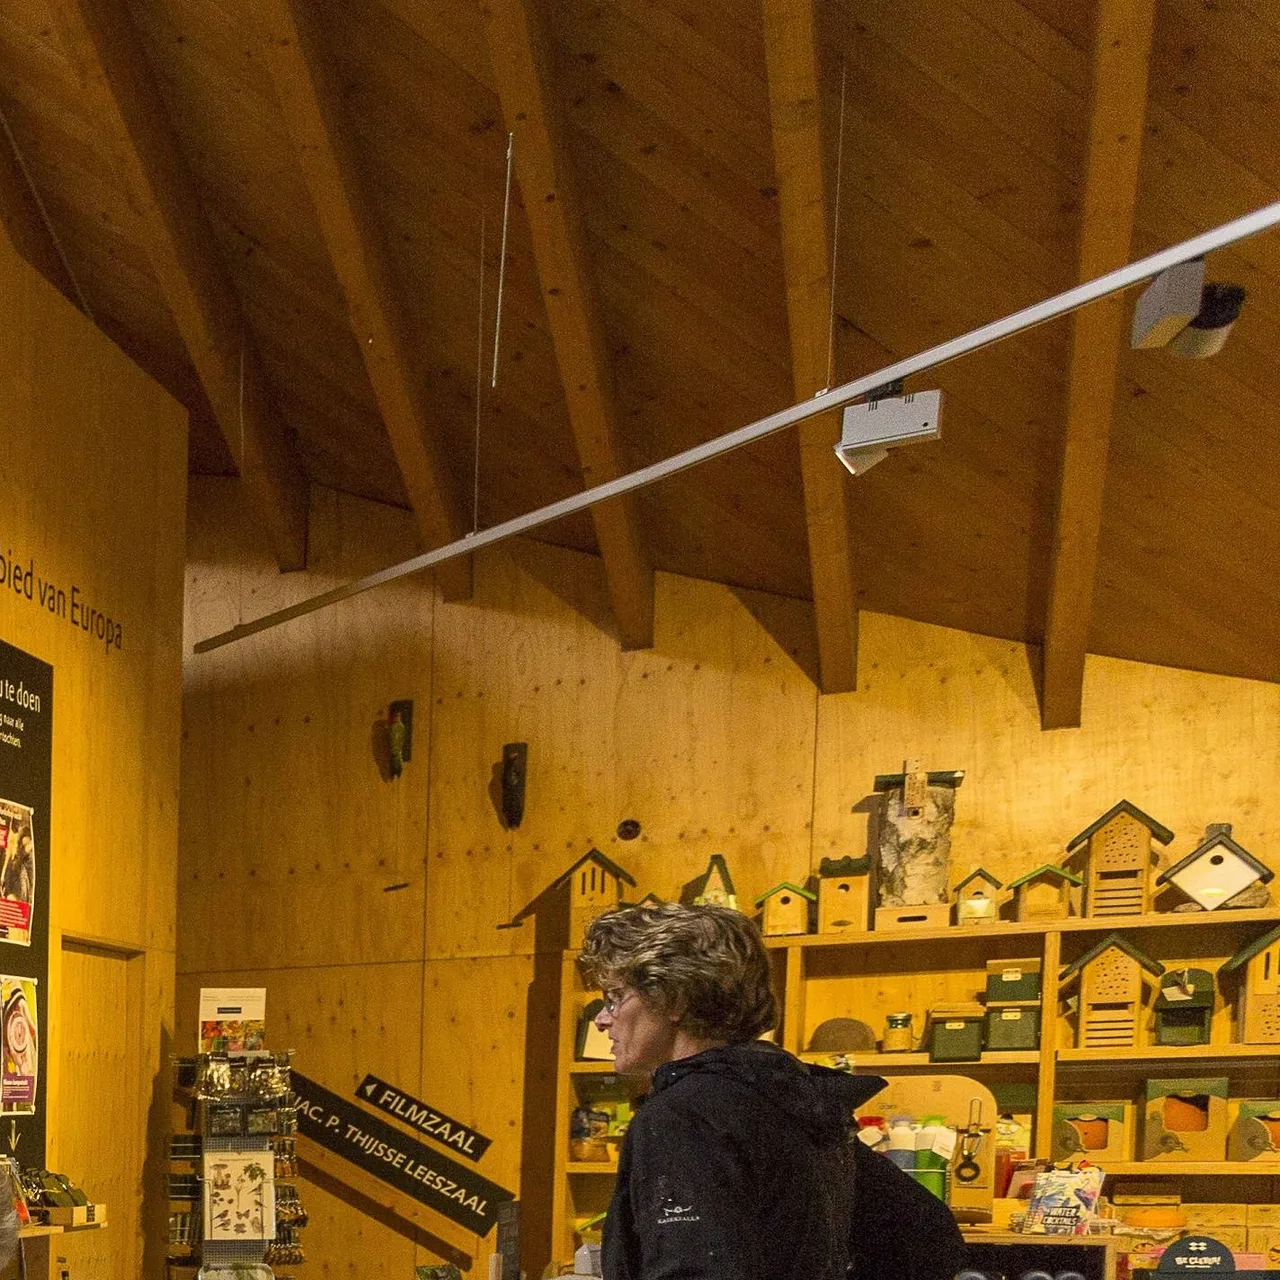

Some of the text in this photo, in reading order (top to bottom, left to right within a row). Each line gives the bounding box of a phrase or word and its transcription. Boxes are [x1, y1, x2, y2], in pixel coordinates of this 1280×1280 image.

[38, 576, 67, 619] van
[71, 584, 124, 655] Europa
[5, 679, 15, 702] te
[16, 681, 42, 713] doen
[378, 1089, 476, 1155] FILMZAAL
[325, 1114, 341, 1133] P.
[344, 1124, 408, 1170] THIJSSE
[403, 1159, 487, 1217] LEESZAAL
